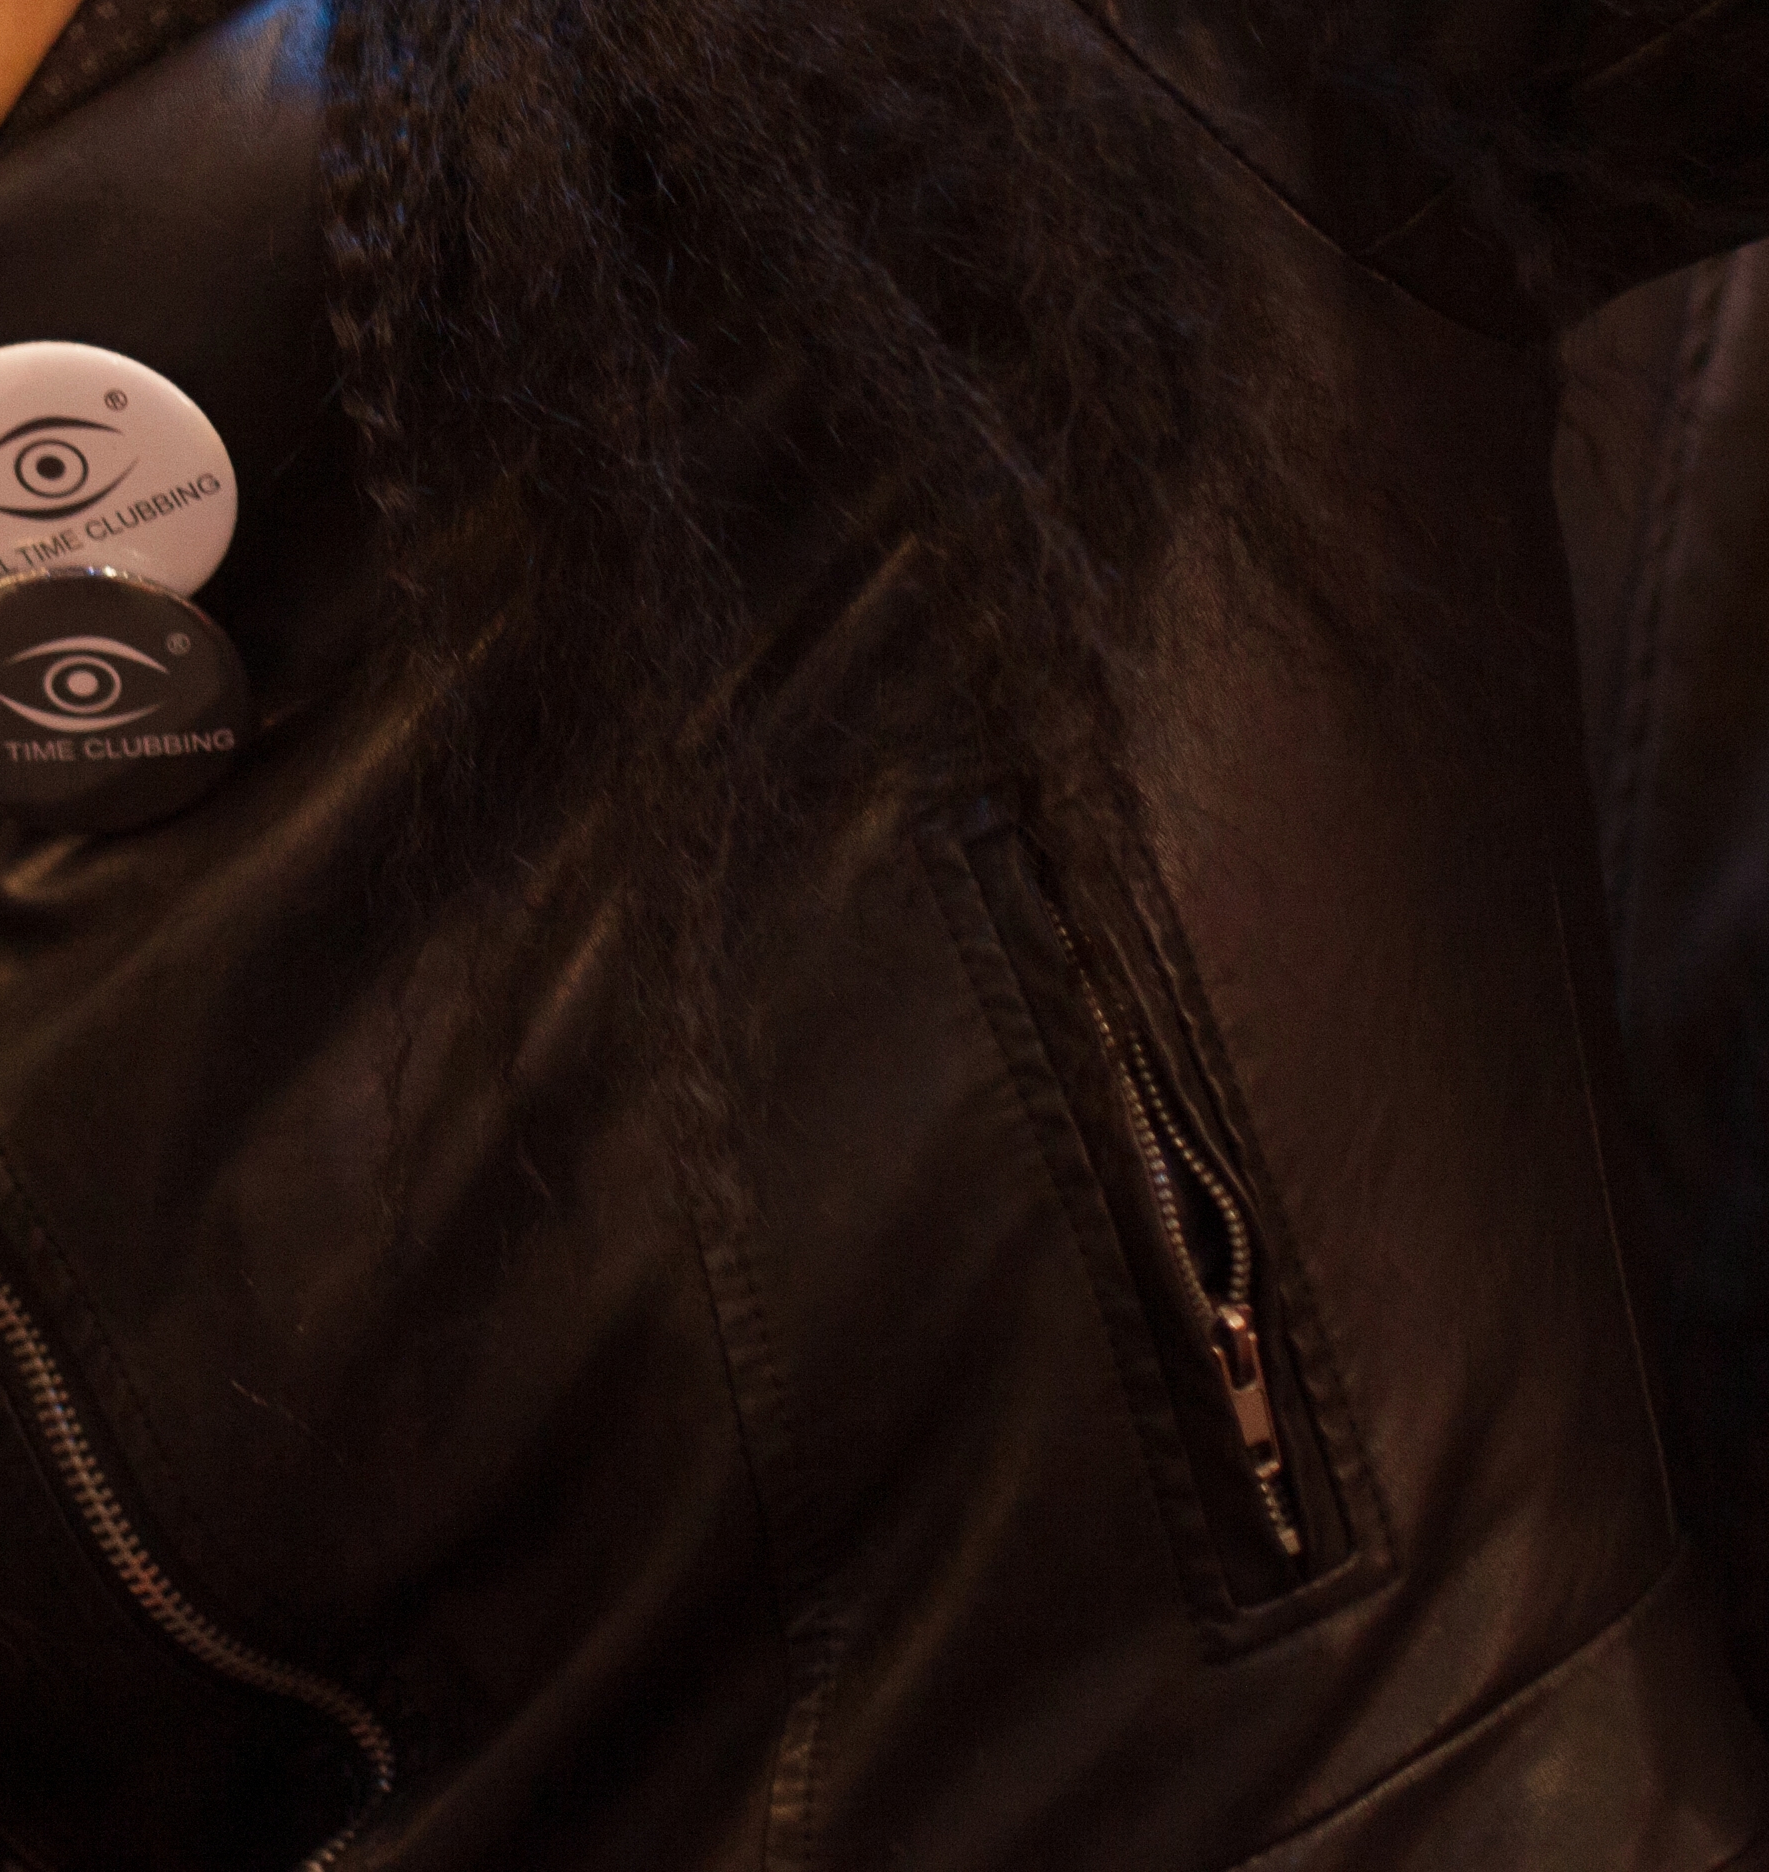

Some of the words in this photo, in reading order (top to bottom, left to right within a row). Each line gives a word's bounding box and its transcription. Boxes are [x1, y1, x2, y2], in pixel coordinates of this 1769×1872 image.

[14, 529, 82, 567] TIME
[85, 472, 220, 542] CLUBBING
[4, 740, 74, 762] TIME
[83, 728, 234, 760] CLUBBING
